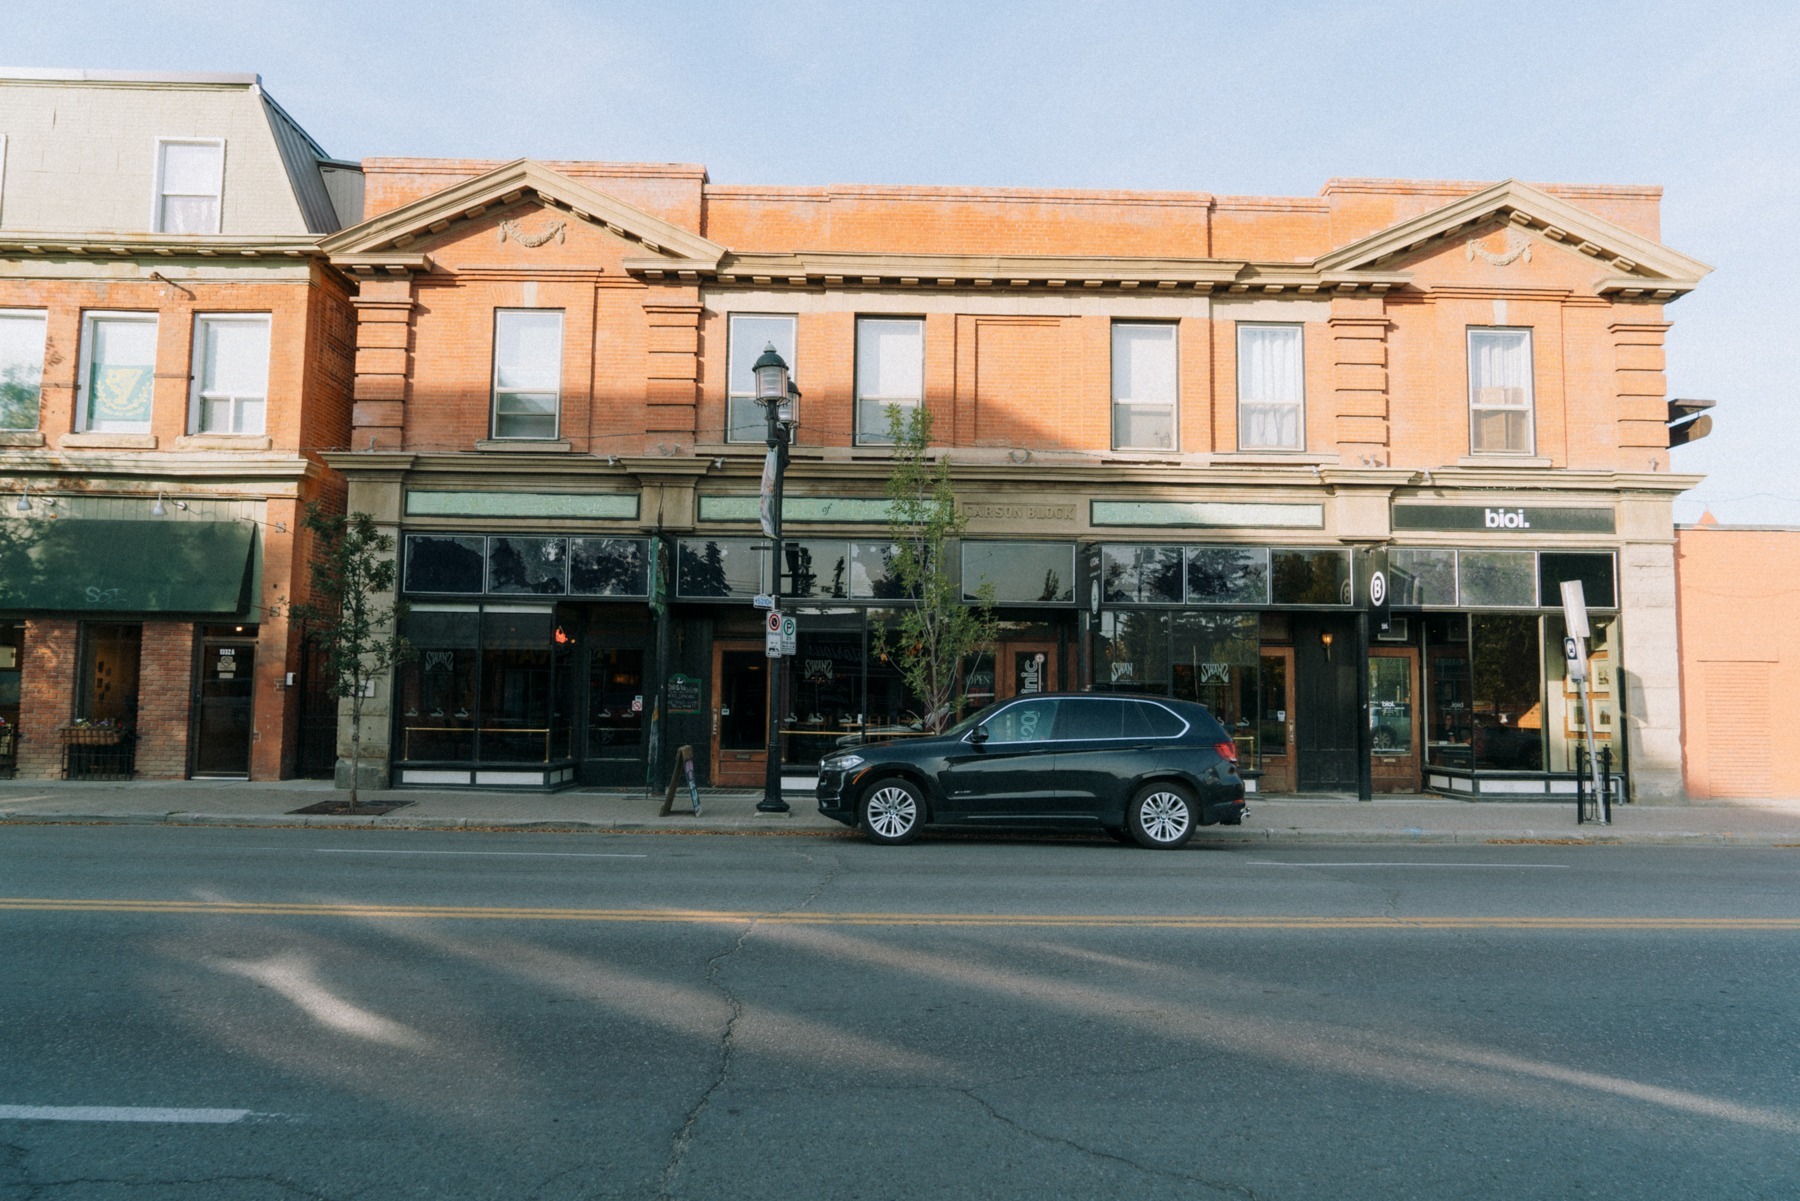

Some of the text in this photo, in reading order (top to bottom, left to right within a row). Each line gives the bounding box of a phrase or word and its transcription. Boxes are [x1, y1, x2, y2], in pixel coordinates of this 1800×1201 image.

[964, 506, 1075, 520] CARSON BLOCK
[1485, 508, 1531, 528] bioi.
[425, 651, 454, 672] SWANS
[804, 659, 833, 680] SWANS
[966, 674, 990, 685] OPEN
[1021, 659, 1038, 693] inic
[1200, 663, 1230, 683] SWANS
